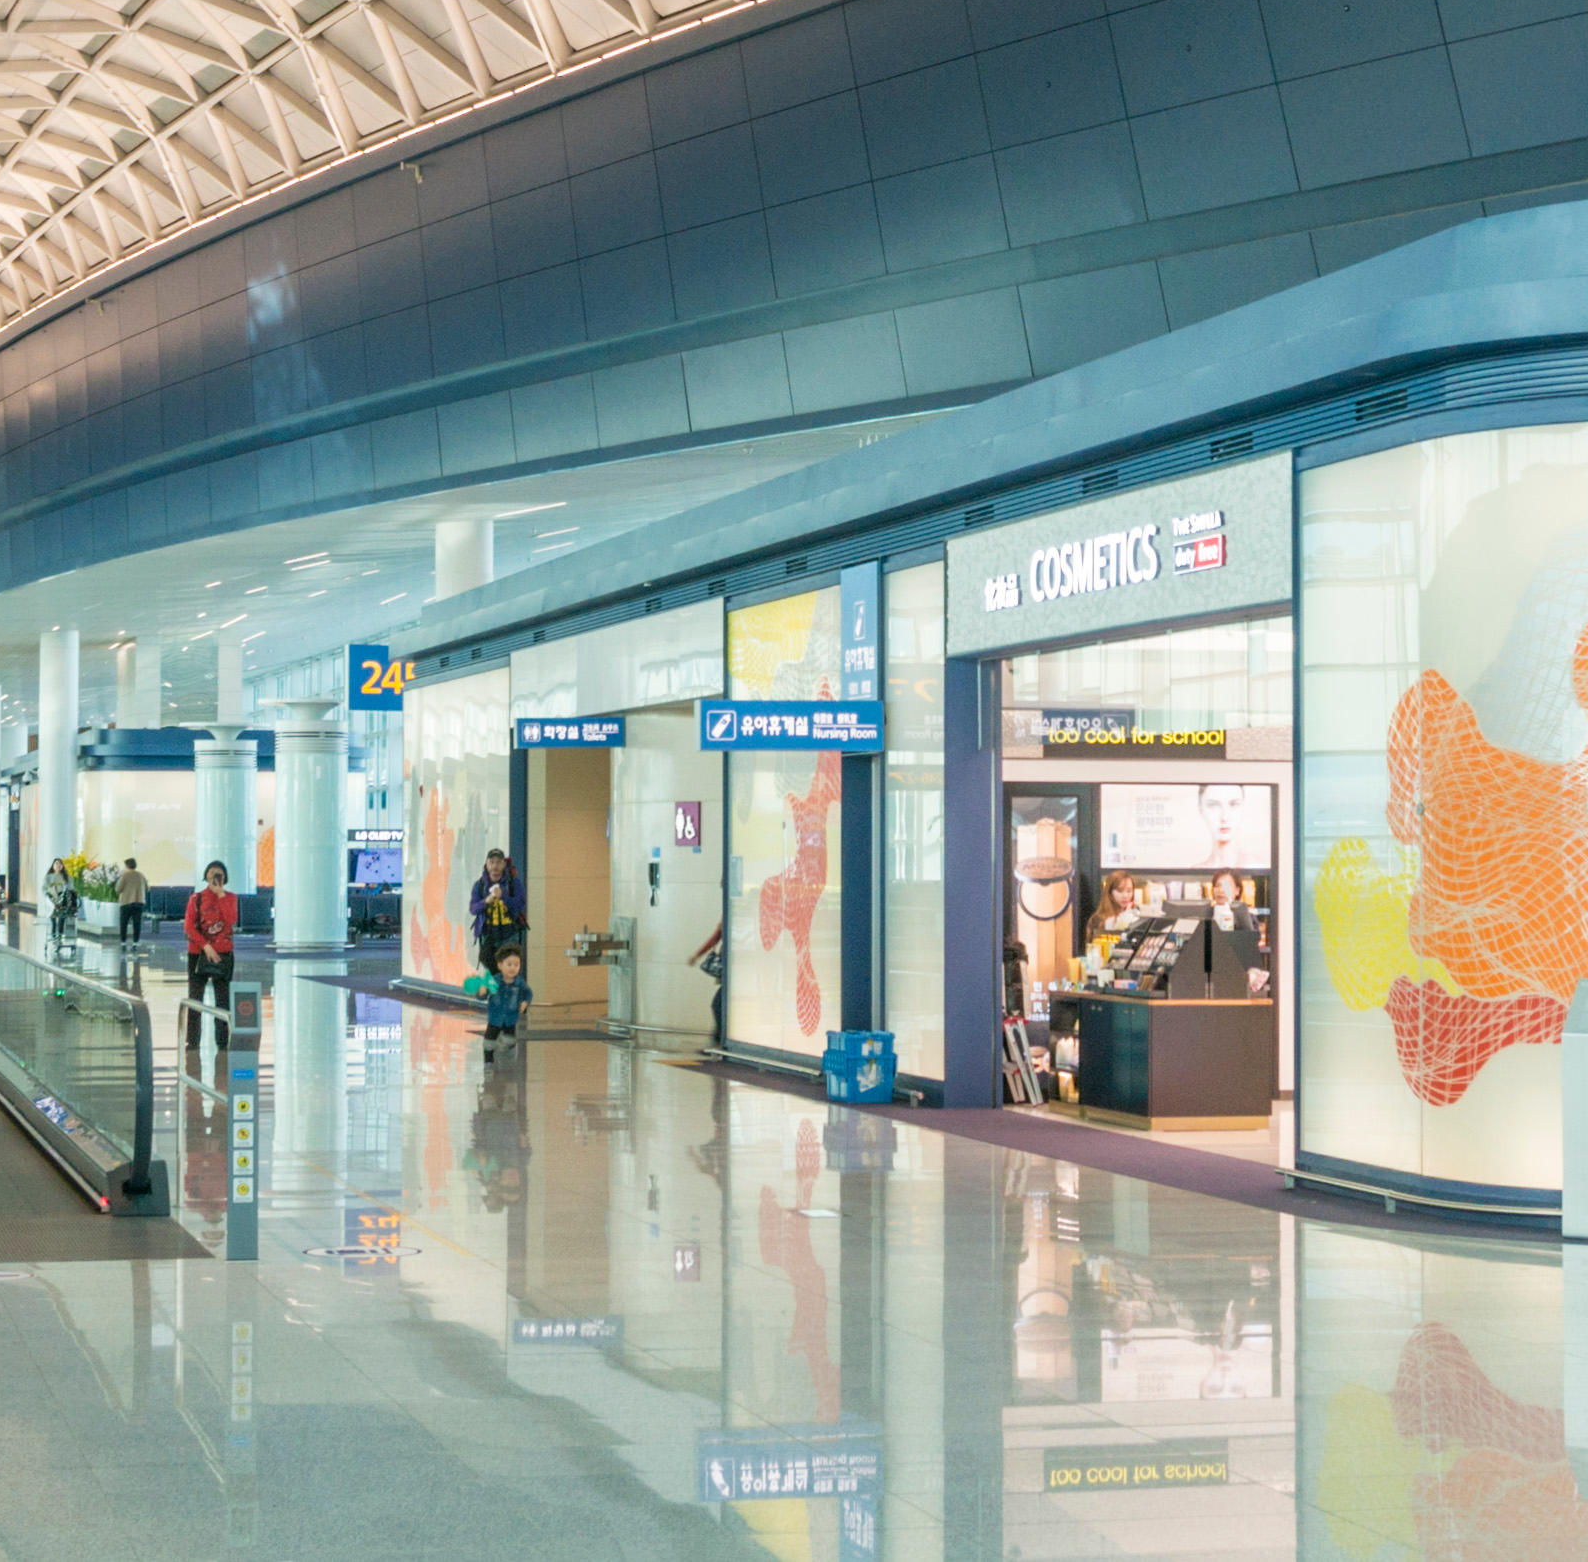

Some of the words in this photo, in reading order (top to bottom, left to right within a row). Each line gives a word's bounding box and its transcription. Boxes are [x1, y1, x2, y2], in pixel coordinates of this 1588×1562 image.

[1029, 523, 1159, 603] COSMETICS
[1175, 547, 1196, 569] duty
[1197, 543, 1219, 562] free
[543, 724, 580, 740] 화장실
[740, 714, 809, 737] 유아휴게실
[813, 728, 848, 741] Nursing
[850, 727, 878, 740] Room
[1049, 727, 1081, 744] too
[1084, 726, 1126, 744] cool
[1131, 725, 1156, 744] for
[1162, 727, 1224, 745] school
